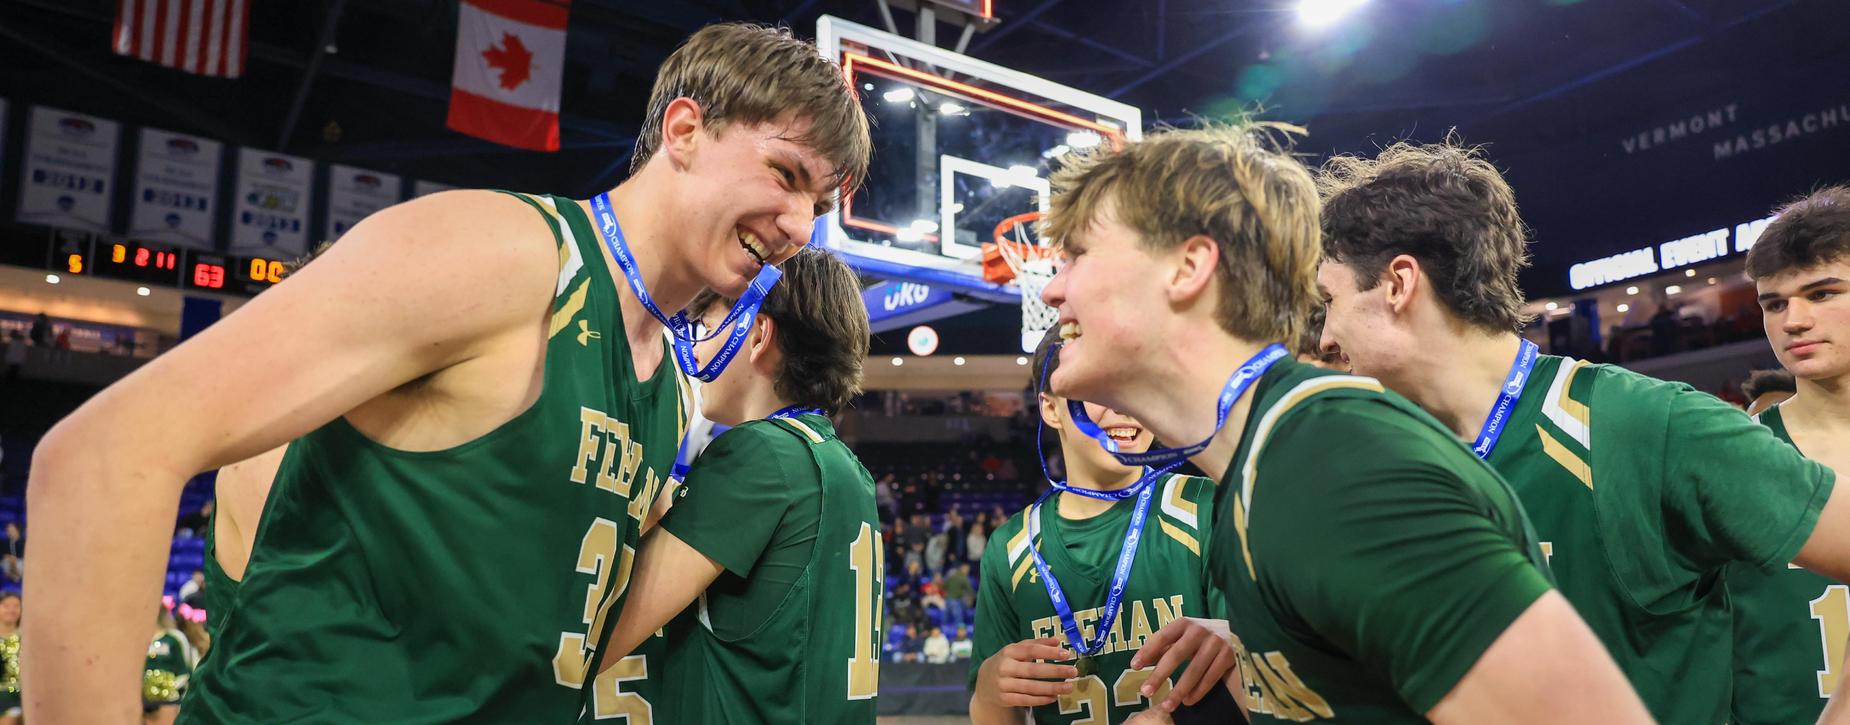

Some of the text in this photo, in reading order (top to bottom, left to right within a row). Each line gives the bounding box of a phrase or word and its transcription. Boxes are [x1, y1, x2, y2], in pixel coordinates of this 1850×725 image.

[1621, 104, 1738, 154] VERMONT
[611, 235, 635, 276] CHAMPION
[194, 263, 225, 288] 63
[710, 336, 739, 373] CHAMPION
[1488, 394, 1512, 434] CHAMPION
[570, 406, 660, 530] FEEA
[1120, 546, 1133, 575] CHAMPION
[1104, 596, 1116, 627] CHAMPION
